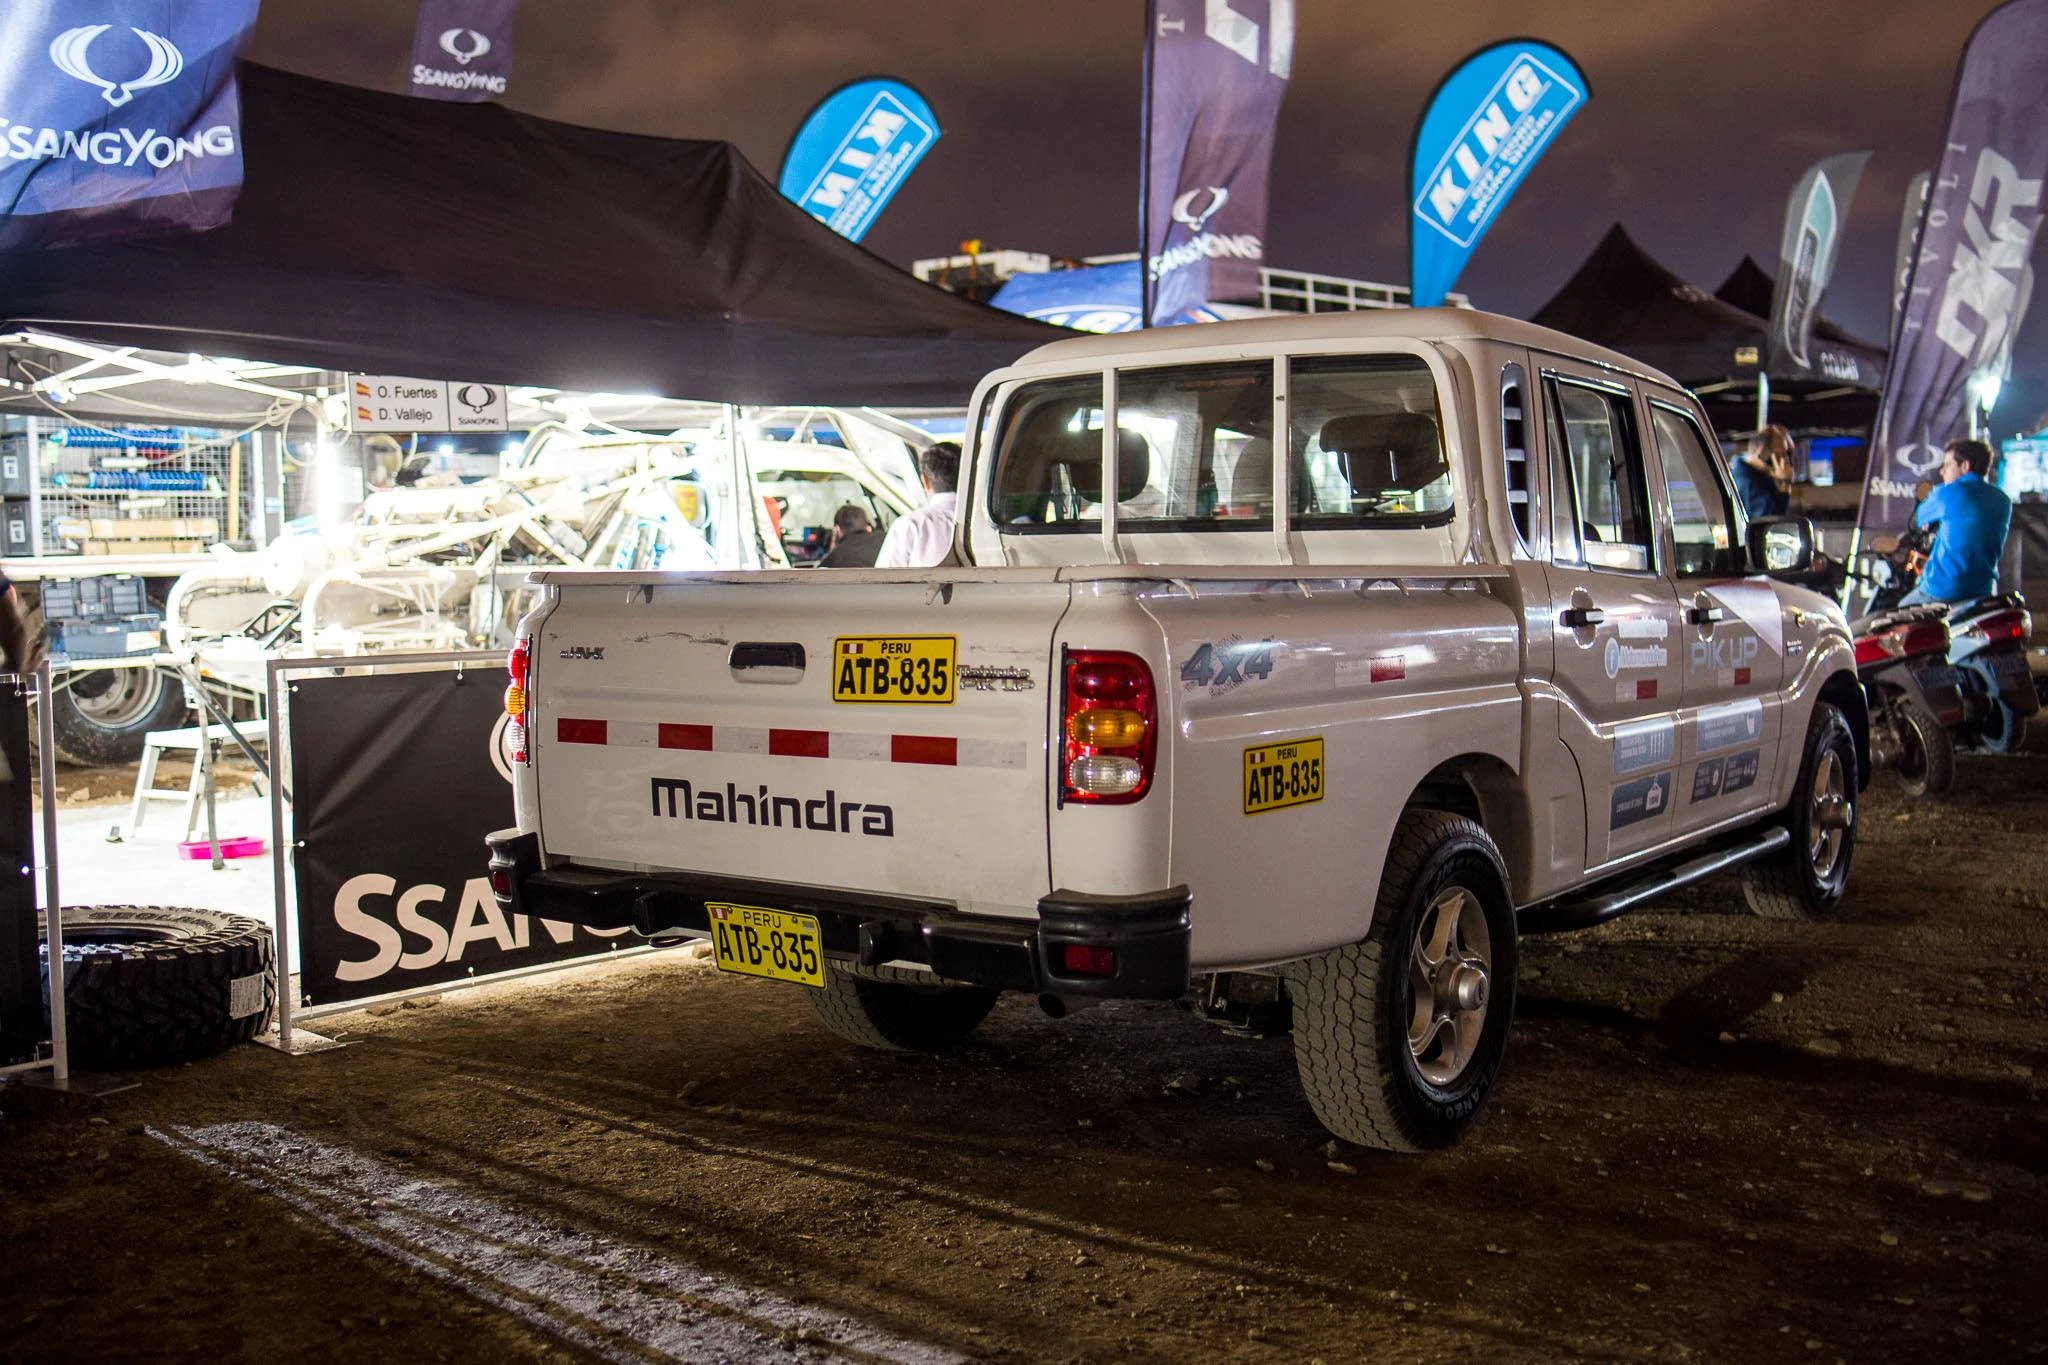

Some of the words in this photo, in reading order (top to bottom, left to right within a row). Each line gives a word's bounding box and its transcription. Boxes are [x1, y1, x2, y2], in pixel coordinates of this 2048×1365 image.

[413, 64, 507, 93] SSANGYONG
[1430, 64, 1543, 224] KING
[1905, 143, 1967, 332] TIVOLI
[377, 386, 391, 398] O.
[395, 386, 438, 399] Fuertes
[379, 408, 392, 420] D.
[395, 408, 432, 423] Vallejo
[881, 642, 912, 654] PERU
[838, 658, 948, 696] ATB-835
[1277, 747, 1298, 760] PERU
[1248, 758, 1320, 806] ATB-835
[651, 777, 894, 837] Mahindra
[743, 911, 781, 928] PERU
[718, 922, 818, 975] ATB-835
